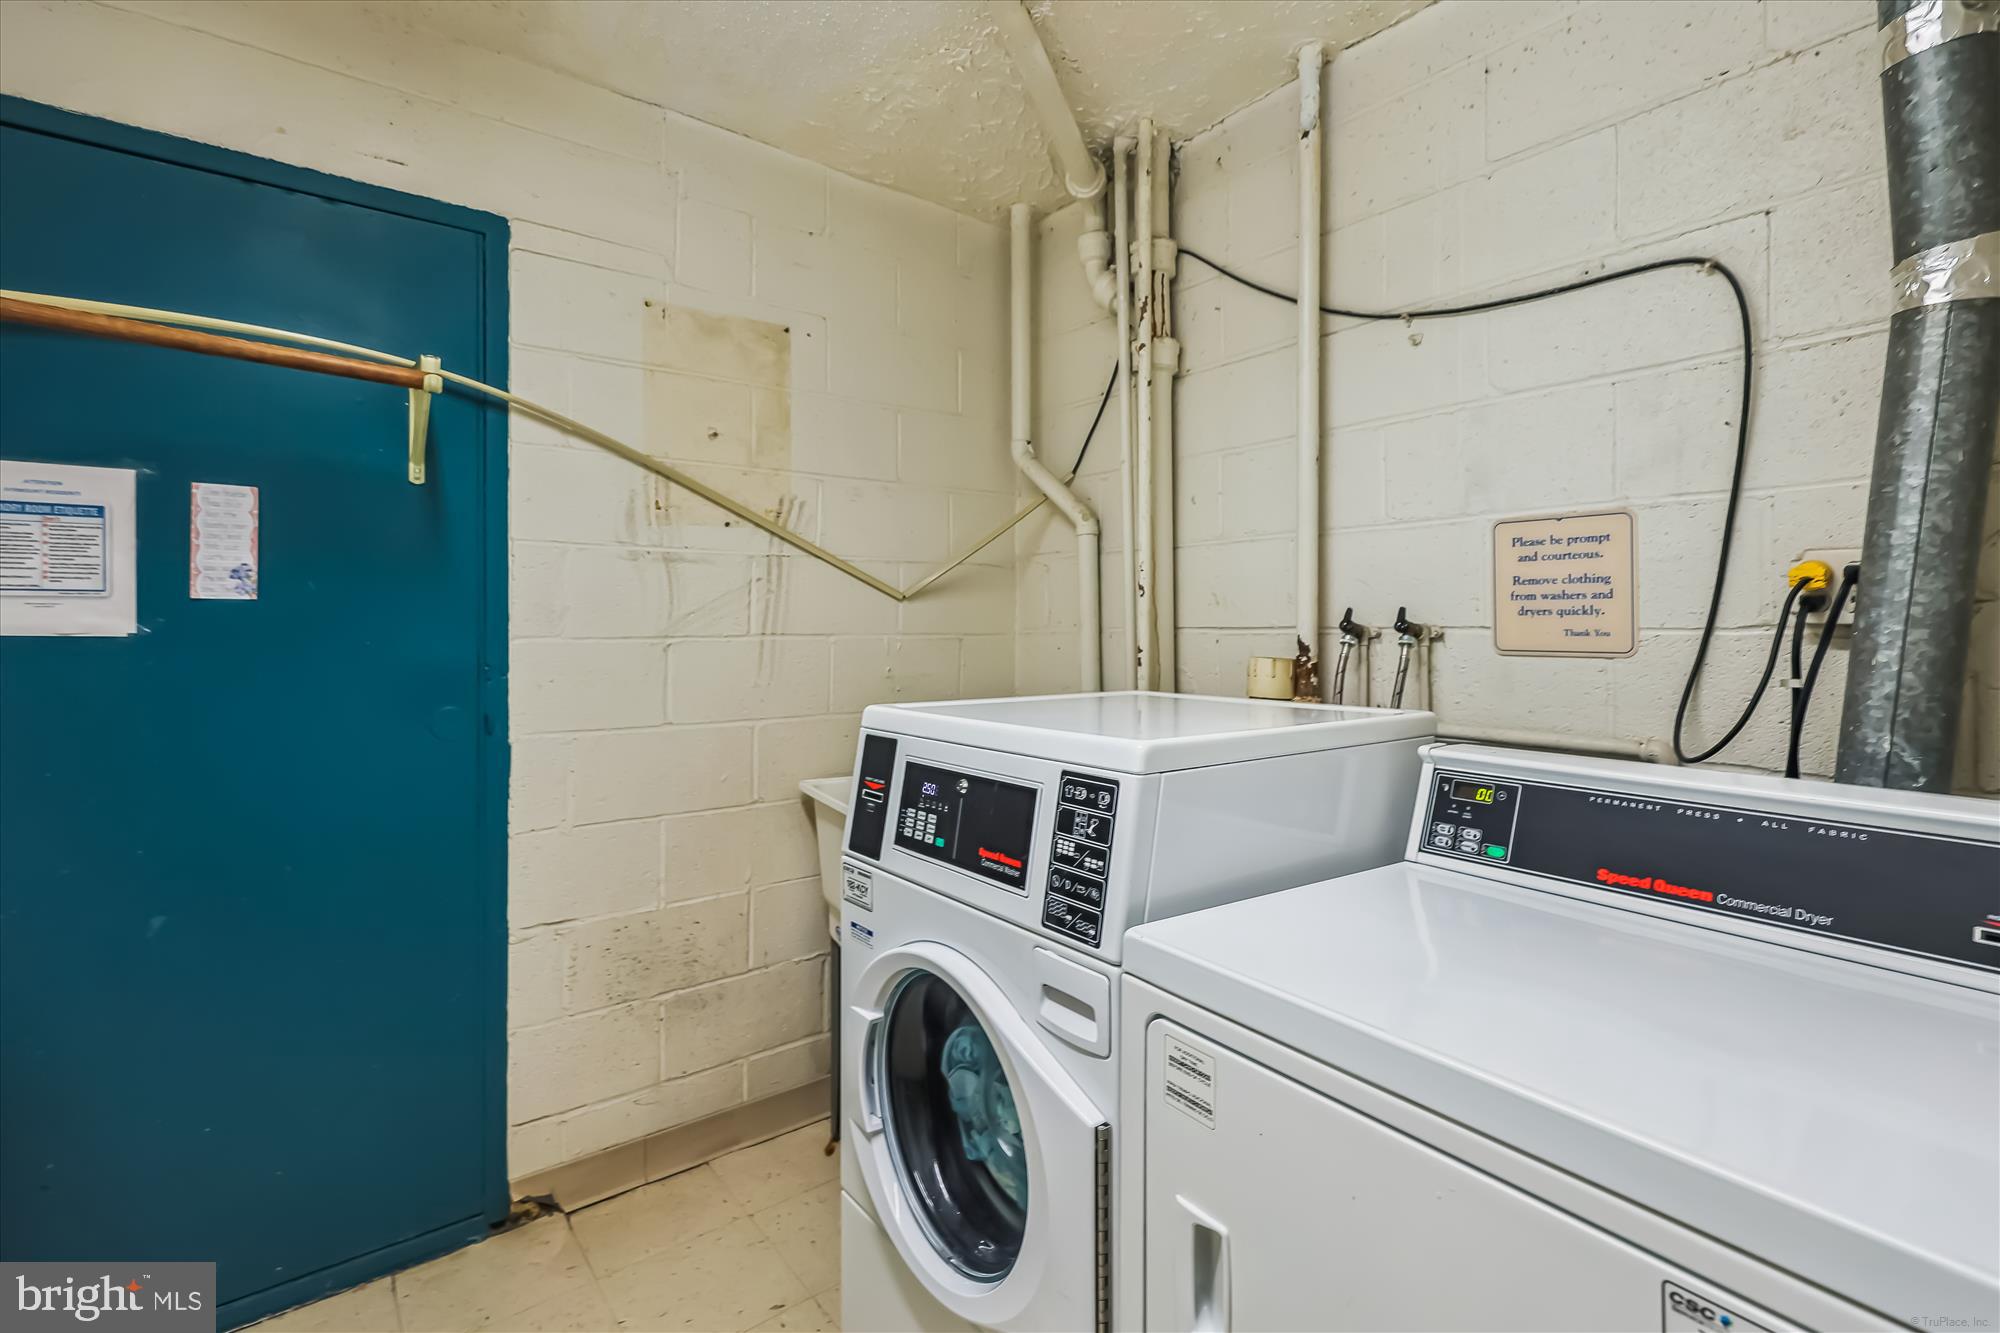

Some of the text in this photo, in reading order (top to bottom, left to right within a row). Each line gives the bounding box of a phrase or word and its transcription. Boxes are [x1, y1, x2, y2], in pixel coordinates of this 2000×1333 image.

[1512, 533, 1611, 548] Please be prompt
[1518, 551, 1604, 562] and courteous.
[1512, 573, 1612, 586] Remove clothing
[1510, 588, 1614, 601] from washers and
[1517, 605, 1606, 618] dryers quickly.
[1564, 629, 1611, 637] Thank You
[1588, 796, 1868, 841] PERMANENT PRESS ALL FABRIC
[1596, 868, 1834, 927] Speed Queen Commercial Dryer
[1669, 1291, 1716, 1321] CSC
